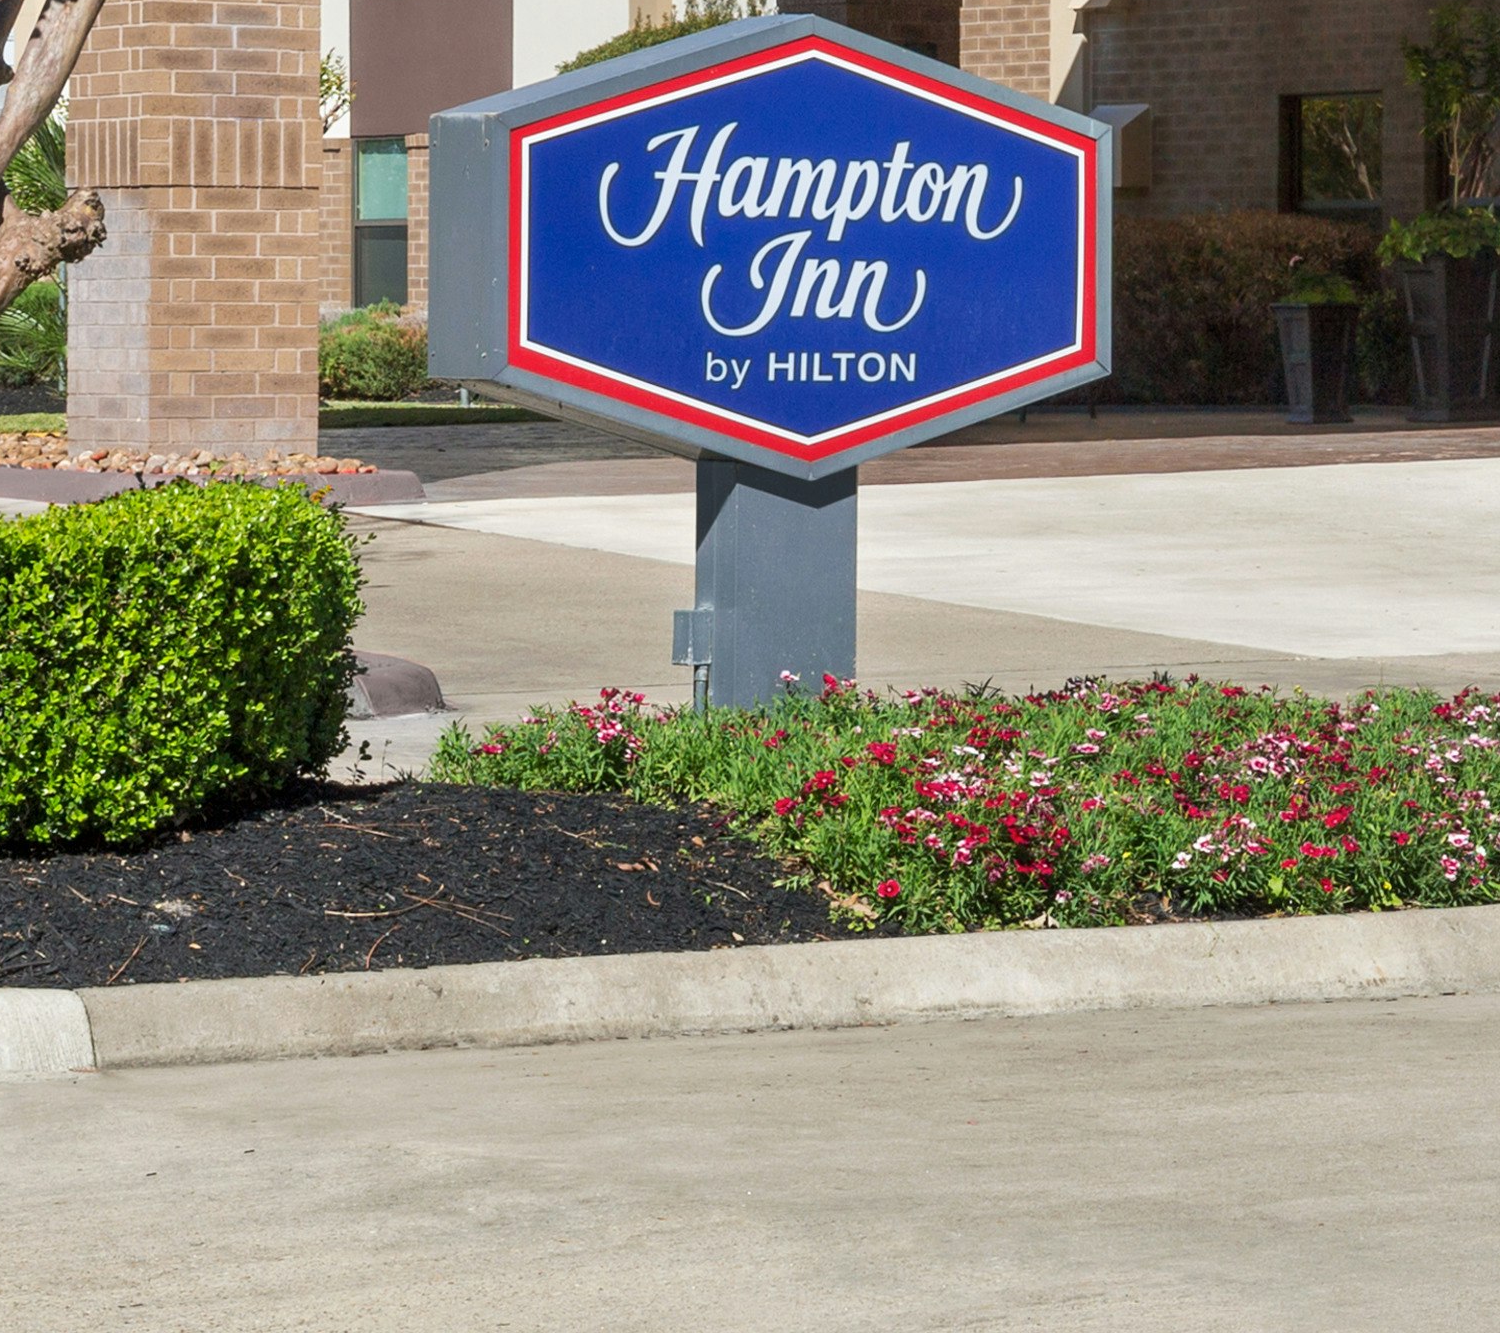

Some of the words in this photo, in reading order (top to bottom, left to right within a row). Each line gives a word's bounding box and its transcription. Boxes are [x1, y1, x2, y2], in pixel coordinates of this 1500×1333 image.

[599, 121, 1022, 248] Hampton
[700, 230, 926, 336] Inn
[705, 352, 751, 389] by
[767, 352, 917, 383] HILTON
